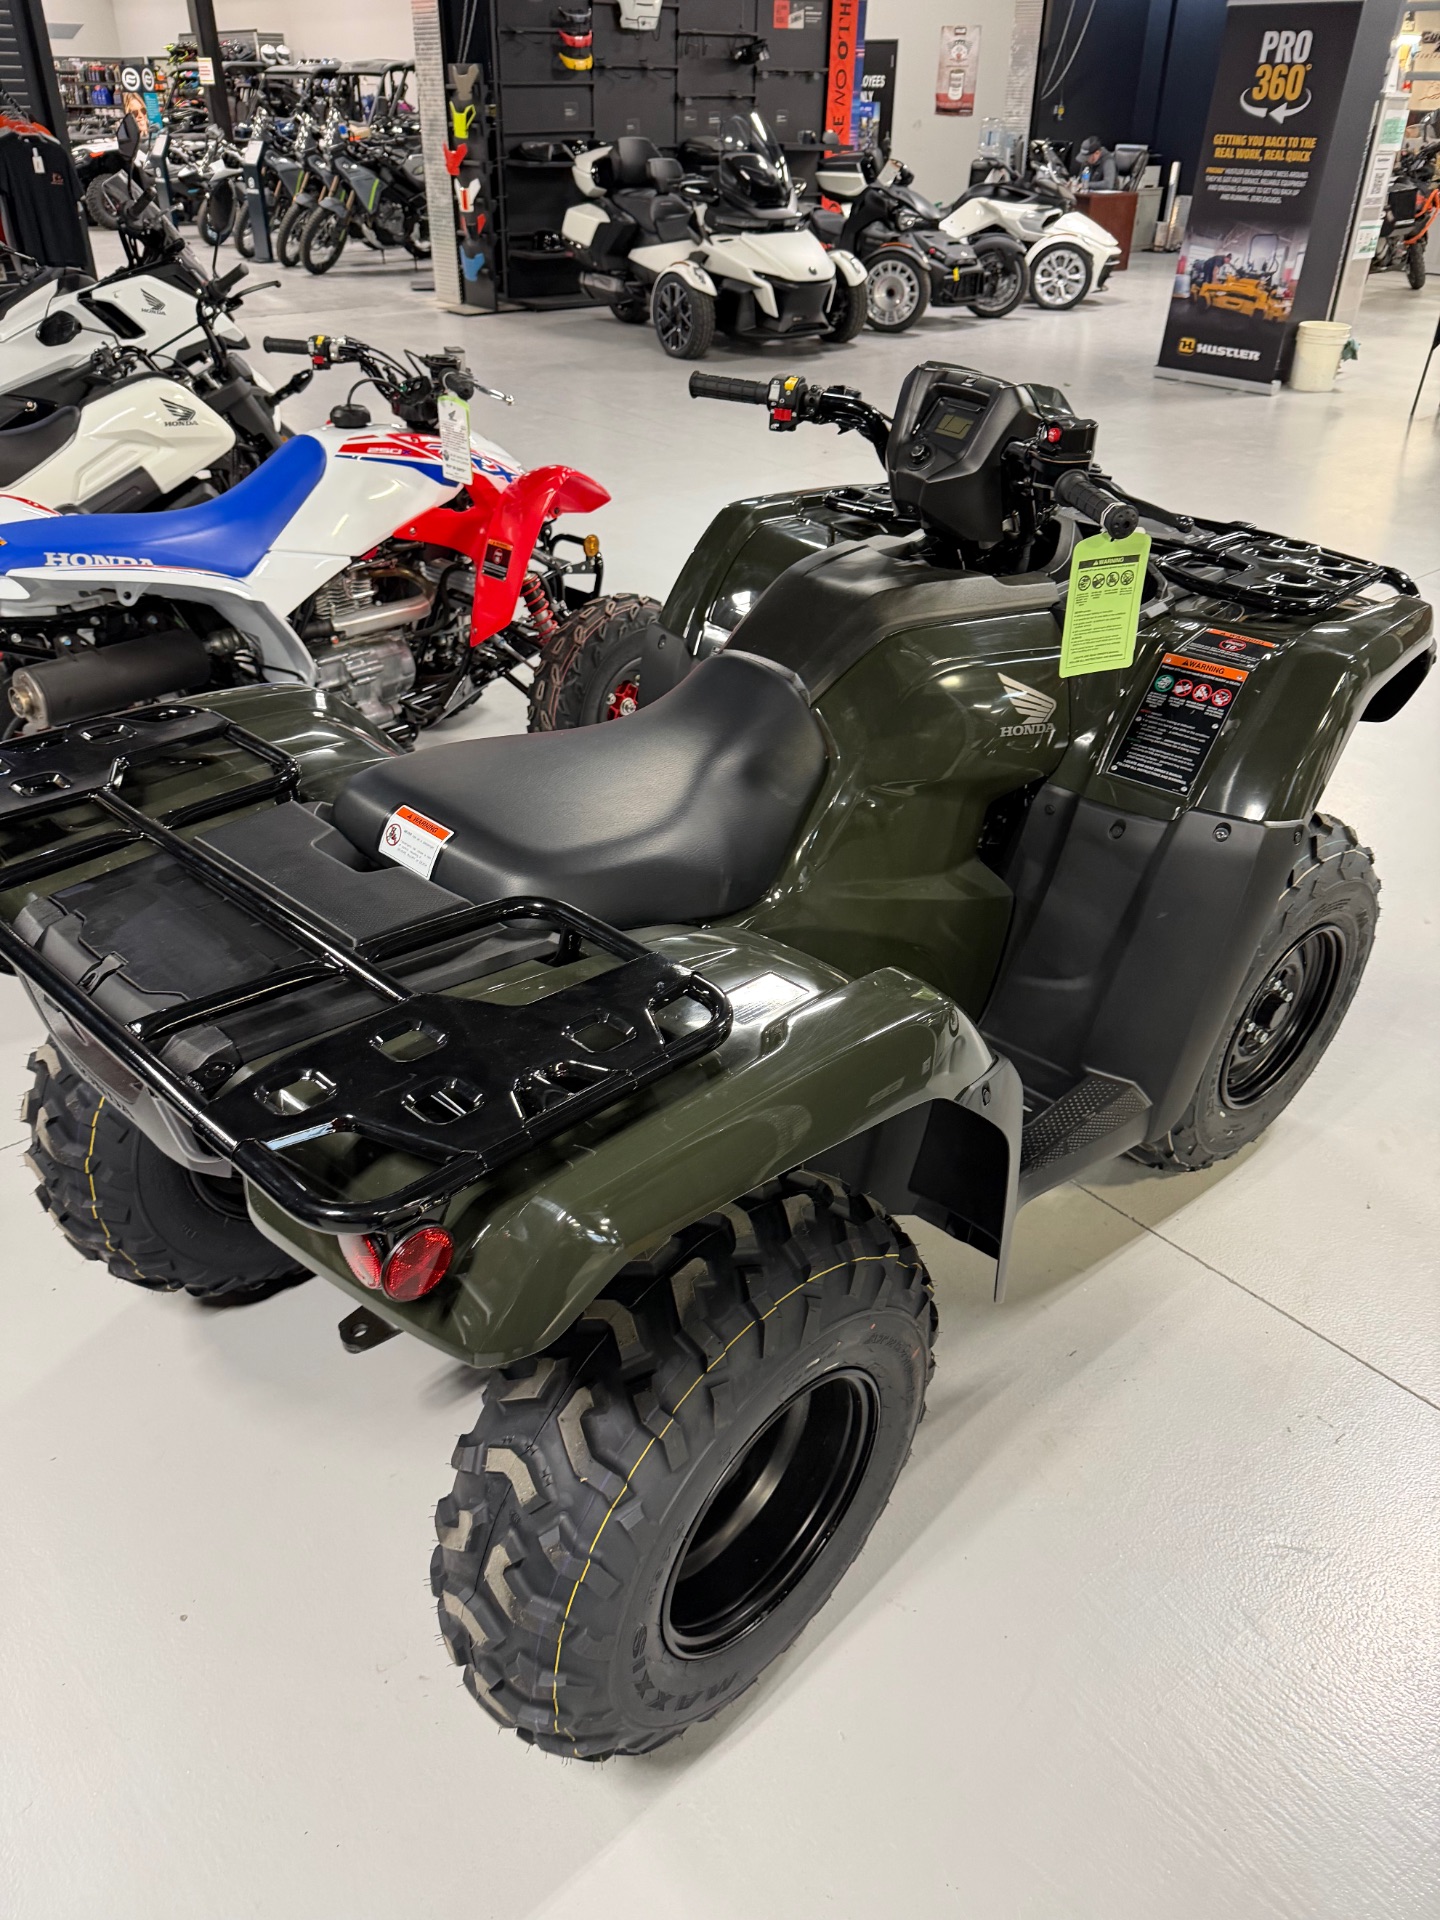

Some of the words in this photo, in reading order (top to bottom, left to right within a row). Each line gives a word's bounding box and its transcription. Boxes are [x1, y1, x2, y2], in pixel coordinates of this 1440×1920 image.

[1258, 30, 1314, 64] PRO
[834, 69, 848, 106] NO
[1213, 134, 1248, 146] GETTING
[1247, 135, 1265, 147] YOU
[1265, 136, 1288, 148] BACK
[1288, 137, 1301, 148] TO
[1300, 137, 1318, 149] THE
[1214, 147, 1235, 158] REAL
[1236, 148, 1263, 162] WORK,
[1264, 150, 1285, 161] REAL
[1285, 151, 1312, 163] QUICK
[141, 307, 167, 316] HONDA
[1196, 343, 1262, 361] HUSTLER
[1098, 556, 1125, 566] WARNING
[1189, 660, 1225, 675] WARNING
[1000, 723, 1055, 738] HONDA
[413, 815, 439, 834] WARNING
